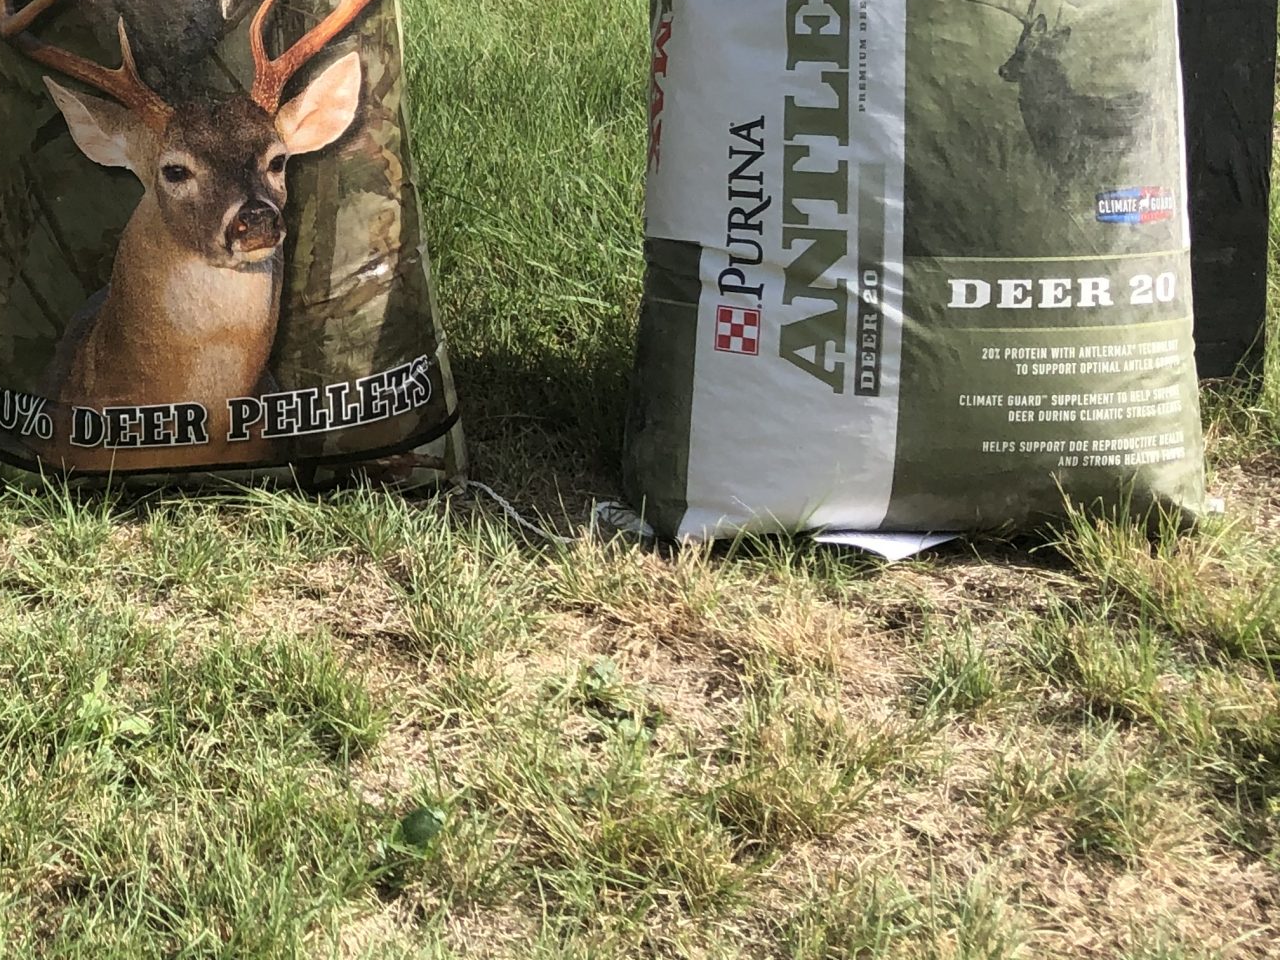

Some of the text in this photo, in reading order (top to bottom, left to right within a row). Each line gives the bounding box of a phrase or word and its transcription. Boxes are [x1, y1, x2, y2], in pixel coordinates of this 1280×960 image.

[858, 39, 867, 113] PREMIUM
[719, 115, 772, 297] PURINA
[1098, 198, 1138, 214] CLIMATE
[947, 271, 1178, 309] DEER 20
[859, 269, 879, 391] DEER 20
[981, 347, 1001, 360] 20%
[1004, 347, 1047, 359] PROTEIN
[1050, 346, 1076, 359] WITH
[1015, 363, 1028, 376] TO
[1032, 362, 1077, 375] SUPPORT
[1080, 360, 1121, 374] OPTIMAL
[1123, 358, 1154, 372] ANTLER
[69, 402, 209, 449] DEER
[226, 355, 433, 441] PELLETS
[959, 394, 1004, 407] CLIMATE
[1051, 392, 1115, 407] SUPPLEMENT
[1116, 391, 1128, 404] TO
[1130, 389, 1151, 403] HELP
[1008, 410, 1035, 422] DEER
[1038, 409, 1077, 422] DURING
[1080, 407, 1124, 421] CLIMATIC
[1126, 404, 1156, 419] STRESS
[982, 441, 1016, 453] HELPS
[1019, 440, 1066, 453] SUPPORT
[1069, 439, 1089, 452] DOE
[1092, 435, 1157, 452] REPRODUCTIVE
[1058, 454, 1079, 467] AND
[1082, 453, 1122, 467] STRONG
